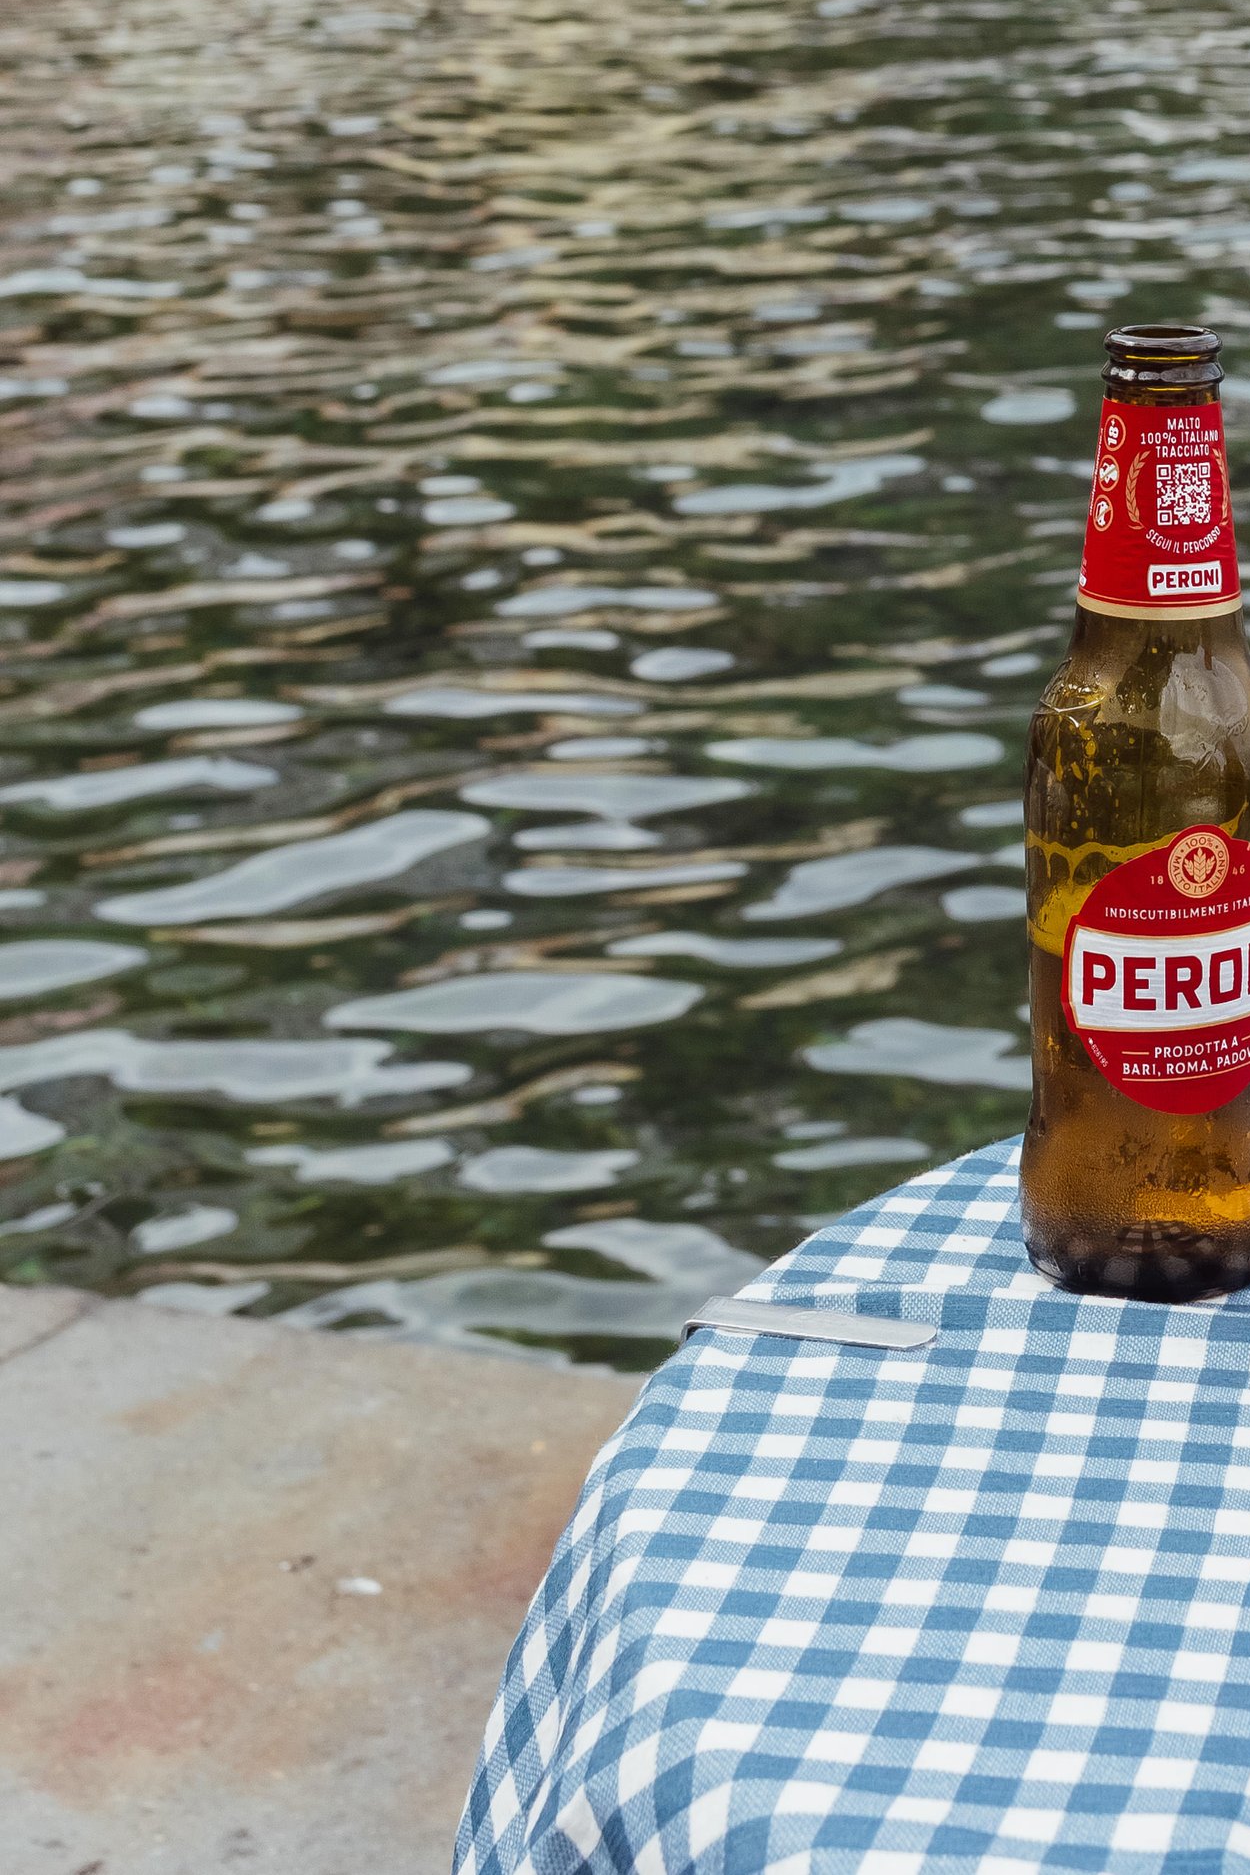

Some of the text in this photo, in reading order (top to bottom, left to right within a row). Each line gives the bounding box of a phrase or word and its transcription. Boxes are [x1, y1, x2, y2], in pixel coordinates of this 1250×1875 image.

[1167, 417, 1200, 430] MALTO
[1140, 431, 1219, 445] 100% ITALIANO
[1155, 445, 1210, 458] TRACCIATO
[1145, 525, 1221, 554] SEGUI IL PERCORSO
[1152, 568, 1219, 589] PERONI
[1150, 864, 1246, 885] 18 46
[1173, 855, 1191, 890] MALTO
[1193, 850, 1226, 893] ITALIANO
[1105, 902, 1229, 920] INDISCUTIBILMENTE
[1154, 1036, 1239, 1059] PRODOTTA A
[1122, 1062, 1161, 1077] BARI,
[1166, 1058, 1214, 1076] ROMA,
